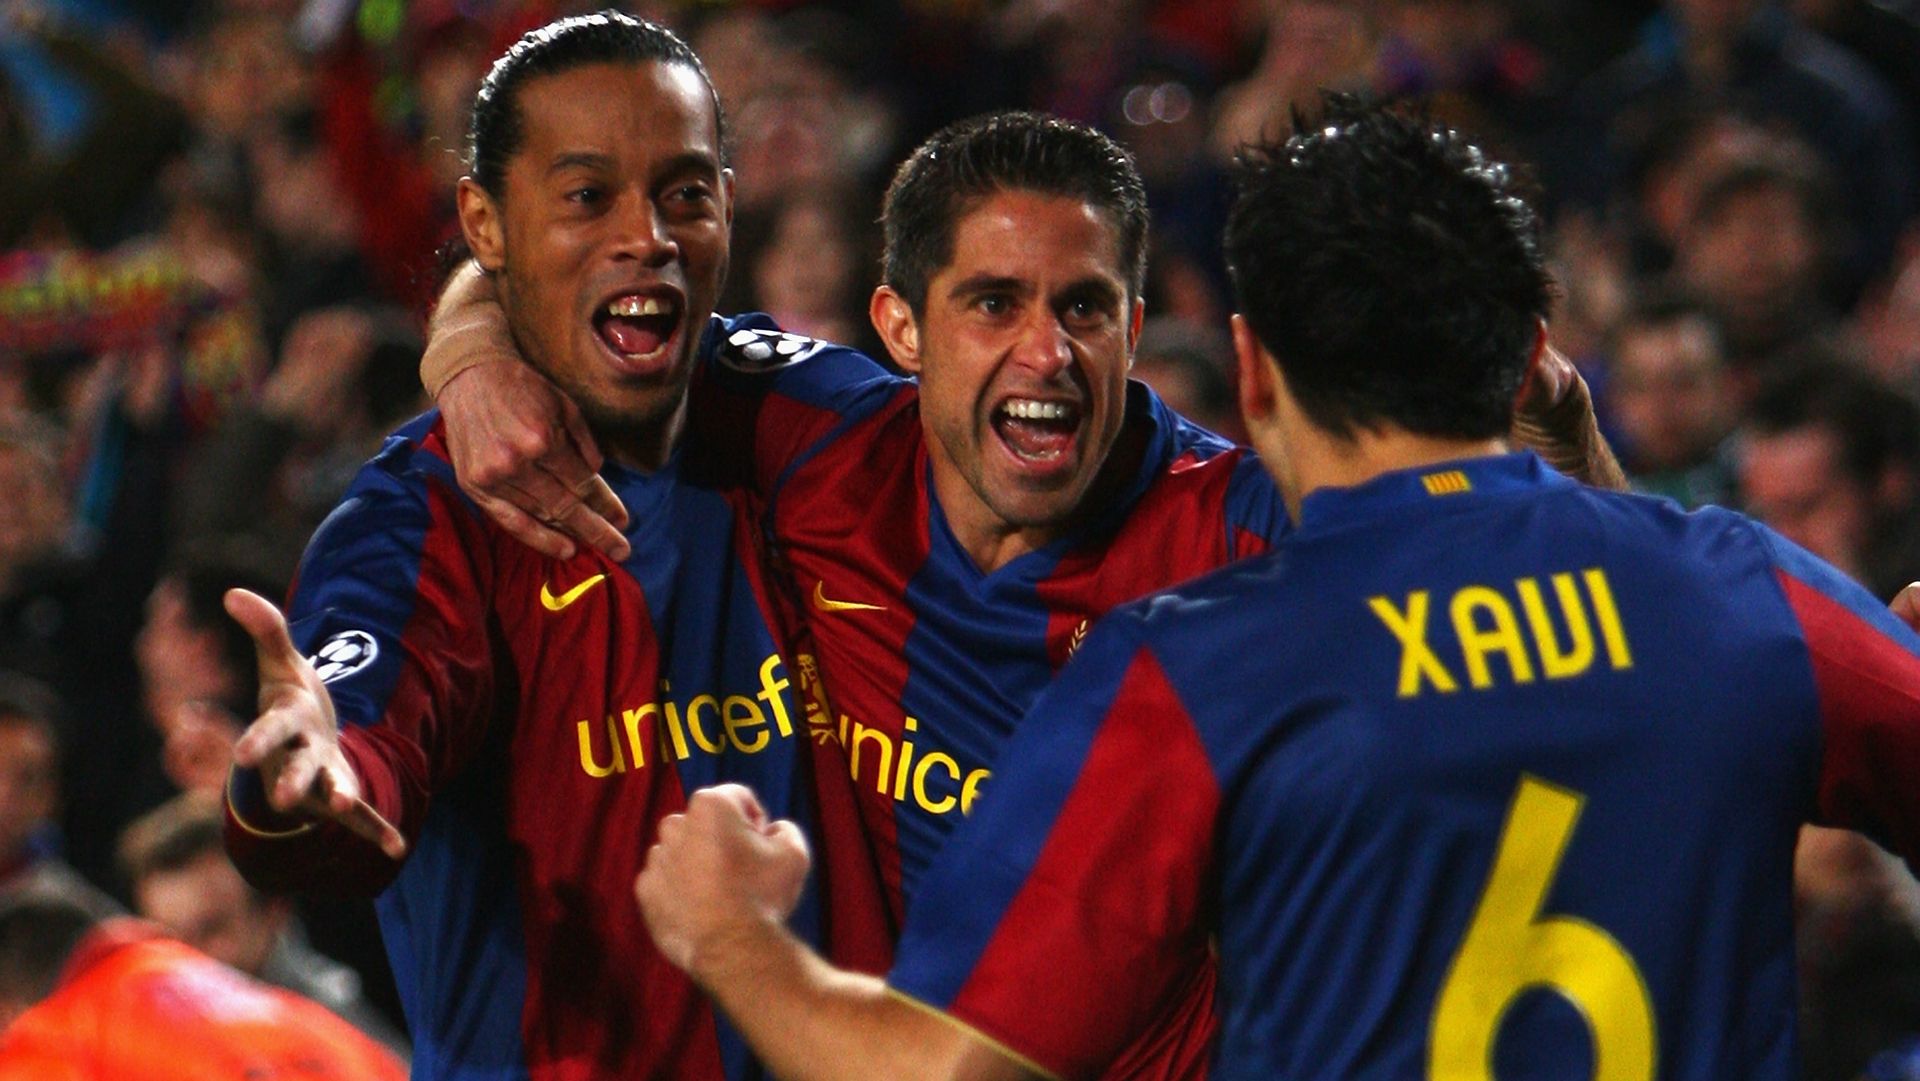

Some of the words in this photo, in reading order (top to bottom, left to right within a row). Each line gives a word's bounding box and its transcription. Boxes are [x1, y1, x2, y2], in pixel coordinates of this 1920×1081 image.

[1367, 567, 1634, 698] XAVI
[577, 654, 794, 777] unicef
[1425, 773, 1658, 1080] 6
